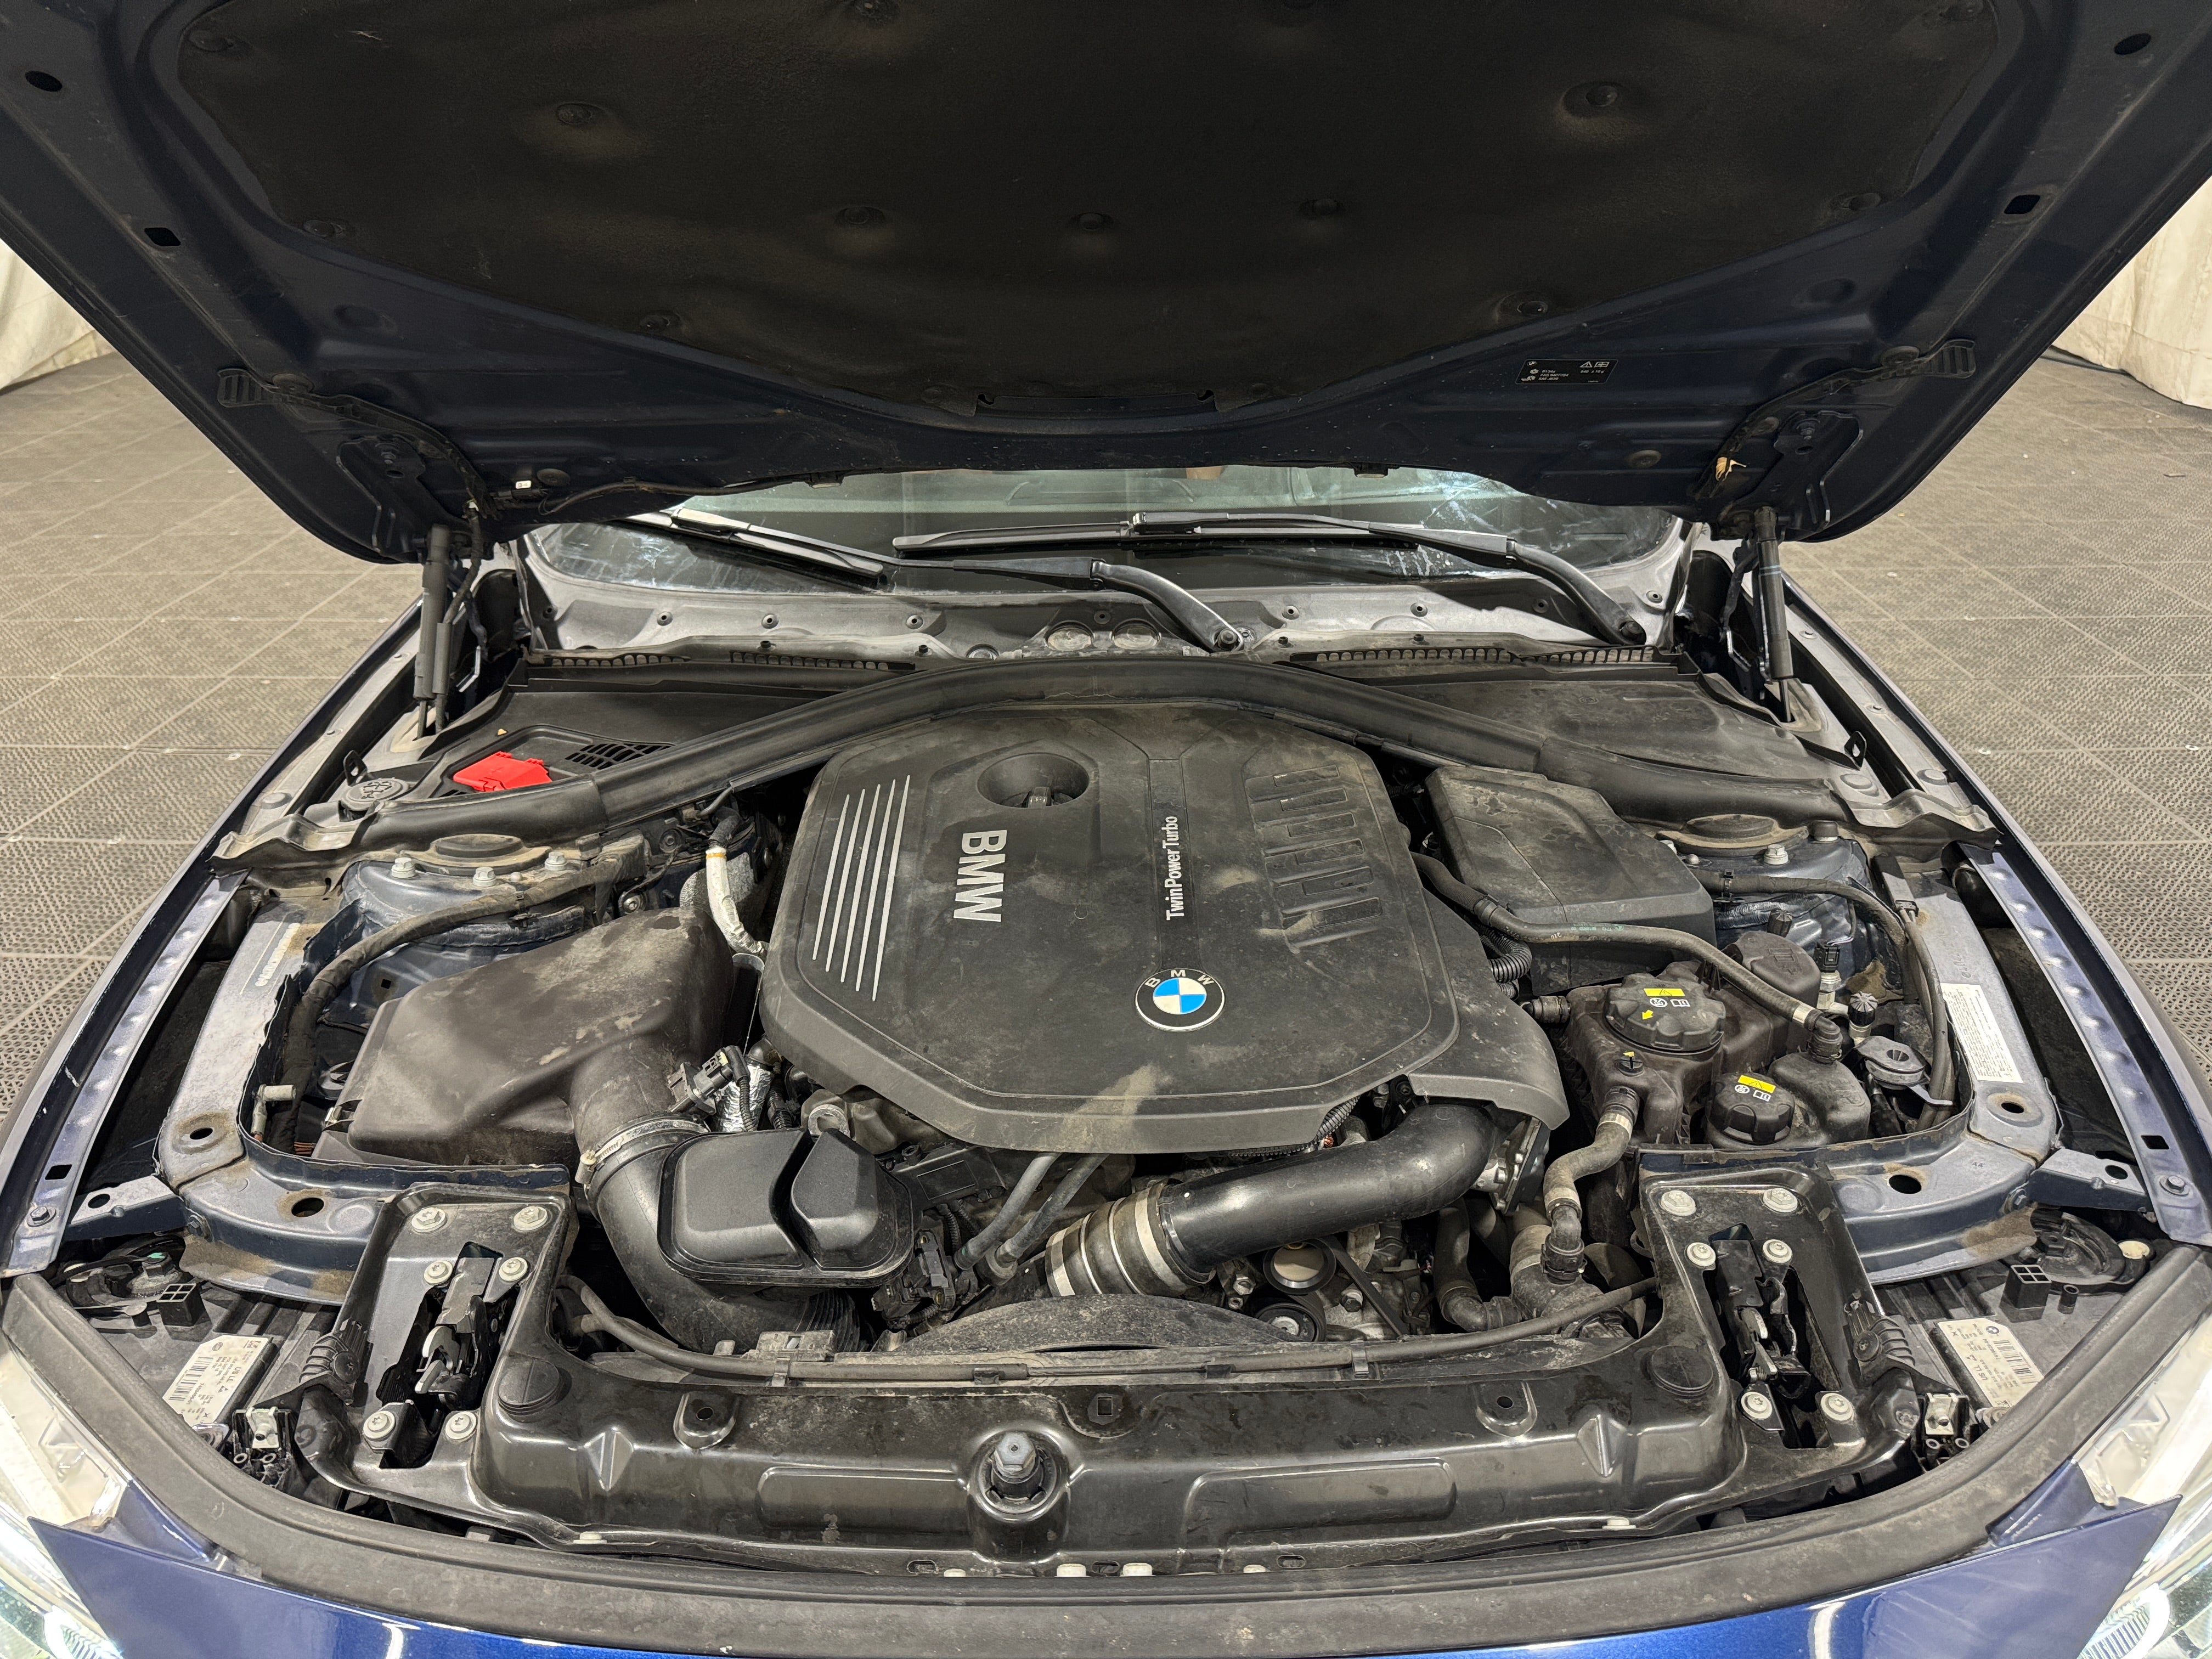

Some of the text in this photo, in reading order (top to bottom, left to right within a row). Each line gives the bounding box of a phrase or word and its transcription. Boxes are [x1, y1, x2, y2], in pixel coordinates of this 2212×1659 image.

[953, 830, 1007, 922] BMW
[1161, 816, 1184, 920] TwinPower Turbo
[1144, 969, 1215, 988] BMW
[232, 1367, 242, 1375] US
